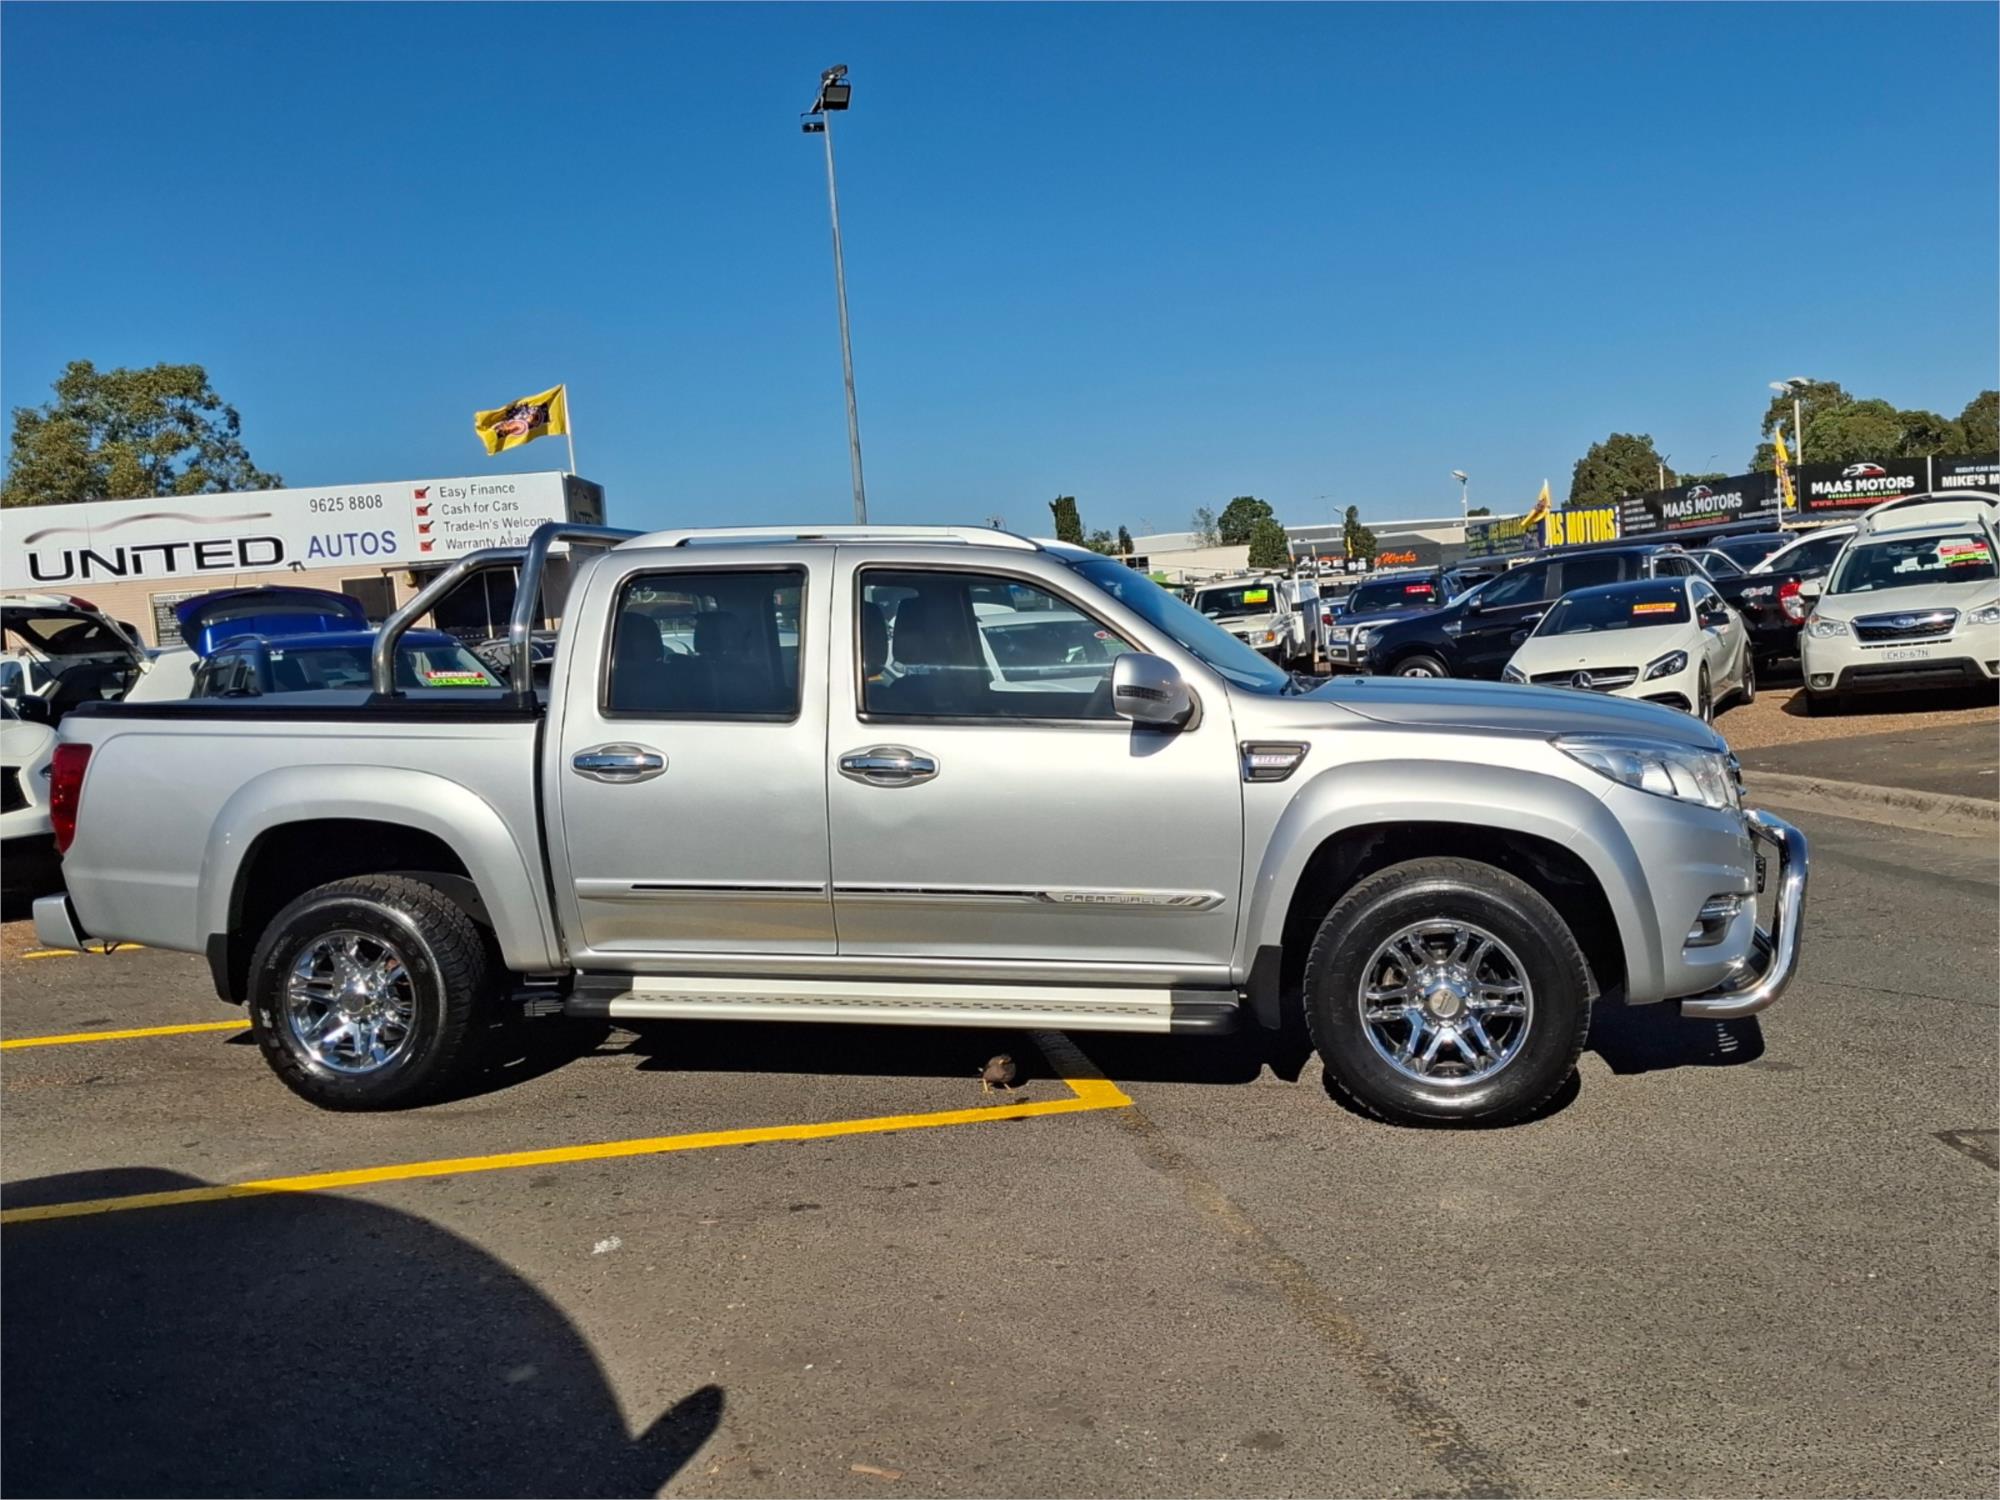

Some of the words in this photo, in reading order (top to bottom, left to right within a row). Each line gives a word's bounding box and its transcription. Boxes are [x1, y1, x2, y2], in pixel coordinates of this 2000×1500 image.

[439, 486, 467, 499] Easy
[470, 483, 515, 495] Finance
[1811, 480, 1853, 495] MAAS
[1855, 475, 1915, 491] MOTORS
[1941, 474, 1986, 488] MIKE'S
[309, 498, 345, 514] 9625
[348, 494, 384, 511] 8808
[442, 503, 471, 516] Cash
[473, 501, 489, 513] for
[492, 500, 519, 512] Cars
[1663, 499, 1693, 518] MAAS
[1694, 492, 1743, 513] MOTORS
[444, 518, 499, 533] Trade-In's
[1566, 508, 1616, 545] MOTORS
[307, 530, 398, 559] AUTOS
[446, 537, 497, 550] Warranty
[499, 534, 532, 547] Avail
[28, 536, 285, 582] UNITED
